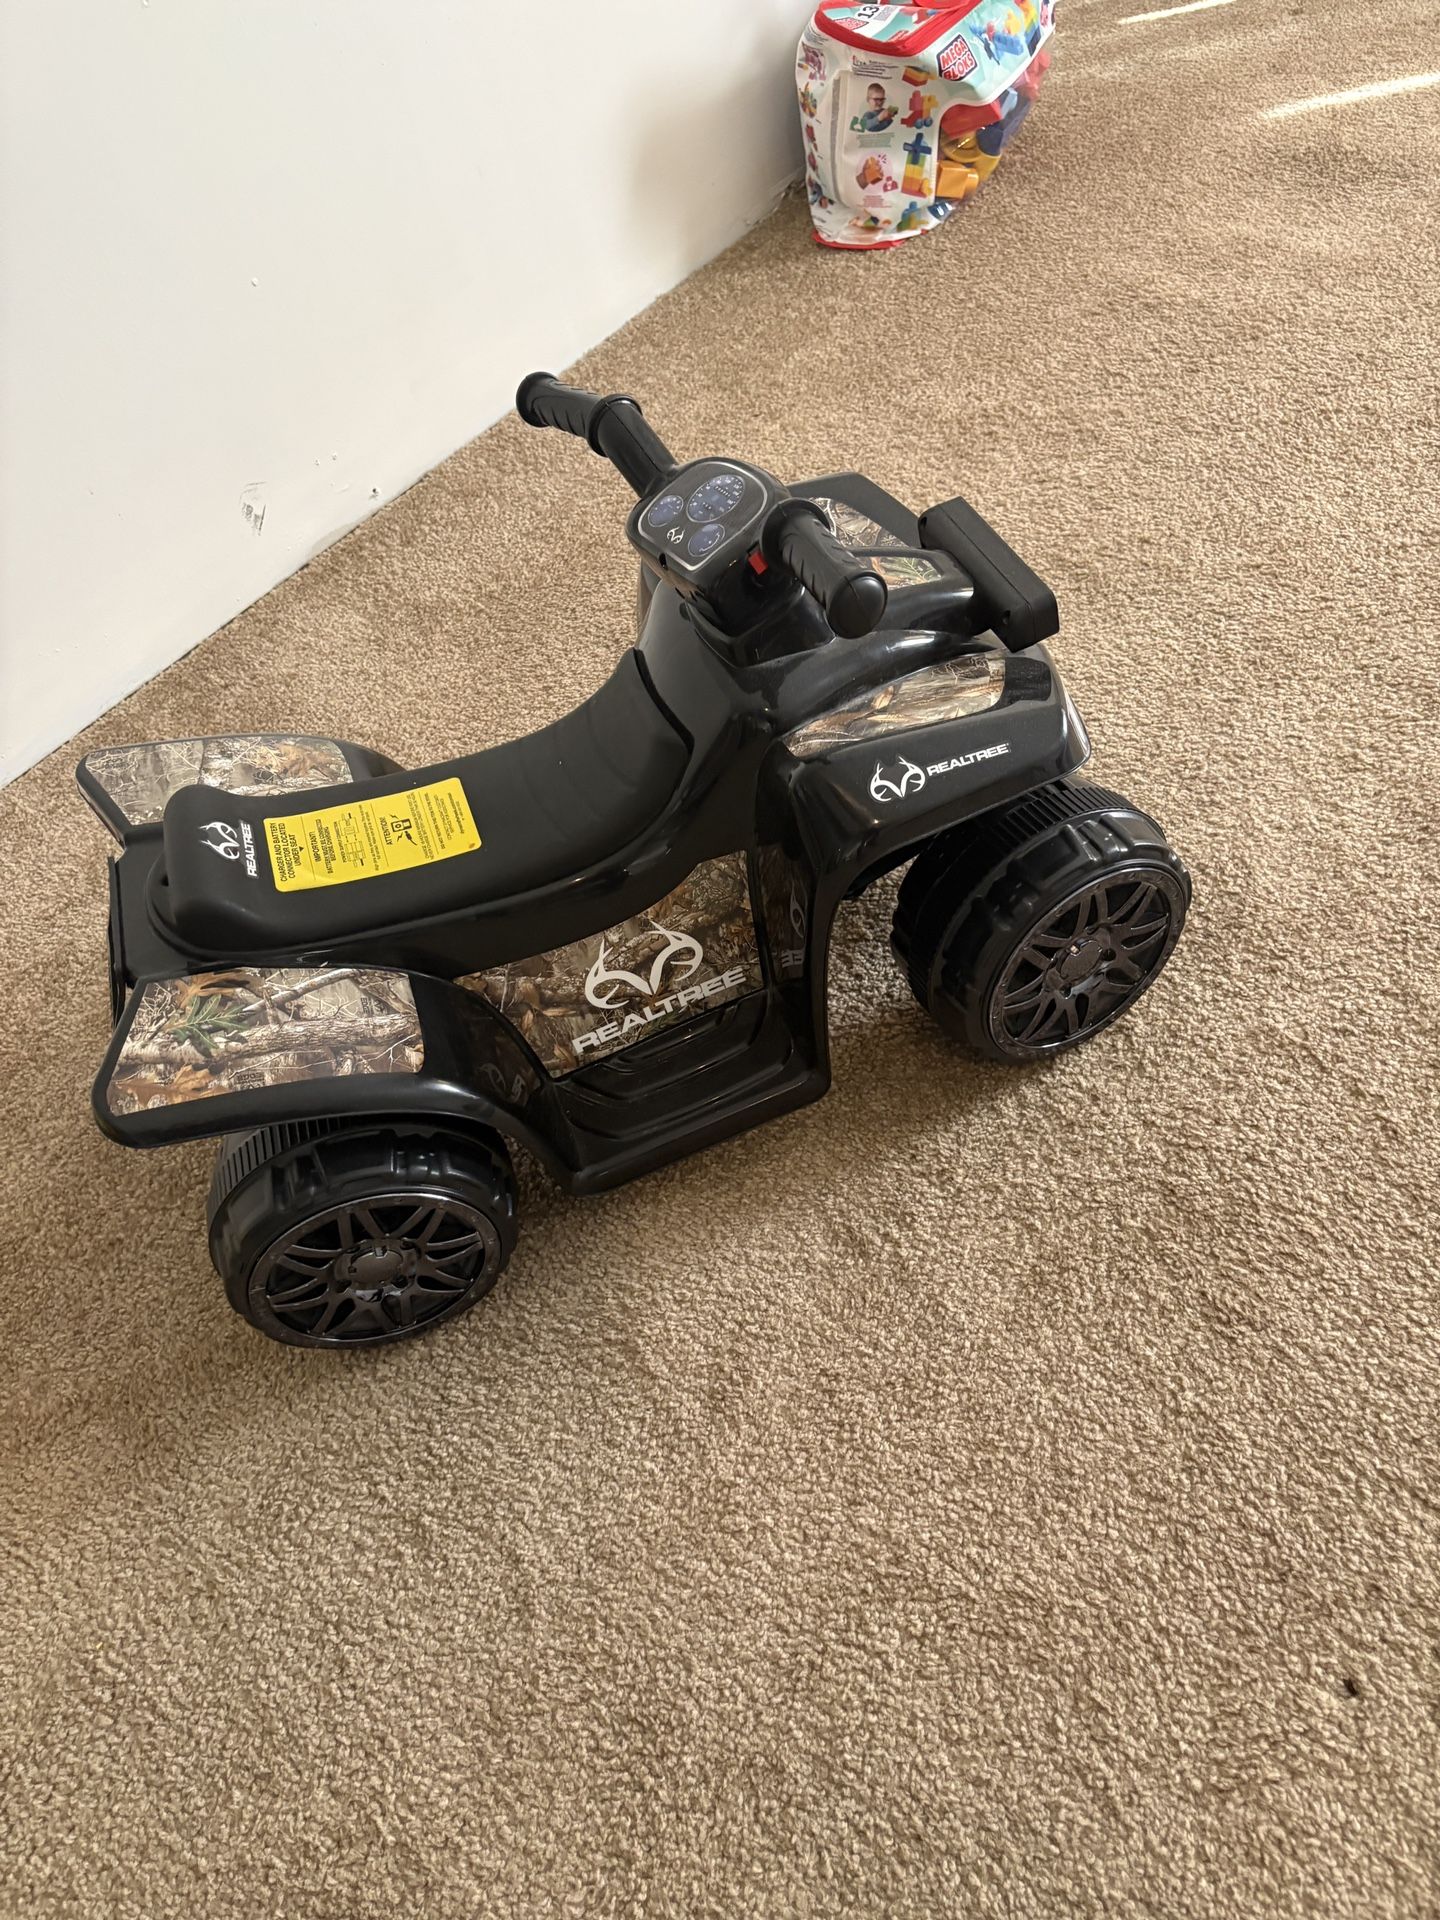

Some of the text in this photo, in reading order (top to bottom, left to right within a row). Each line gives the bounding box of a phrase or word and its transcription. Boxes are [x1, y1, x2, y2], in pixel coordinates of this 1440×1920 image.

[940, 38, 969, 70] MEGA
[942, 51, 976, 80] BLOKS
[926, 743, 1010, 776] REALTREE
[309, 832, 321, 862] IMPORTANT!
[380, 818, 392, 845] ATTENTION!
[241, 822, 257, 877] REALTREE
[270, 823, 287, 882] CHARGER AND BATTERY
[278, 823, 295, 879] CONNECTOR LOCATED
[288, 834, 301, 866] UNDER SEAT
[571, 967, 747, 1055] REALTREE
